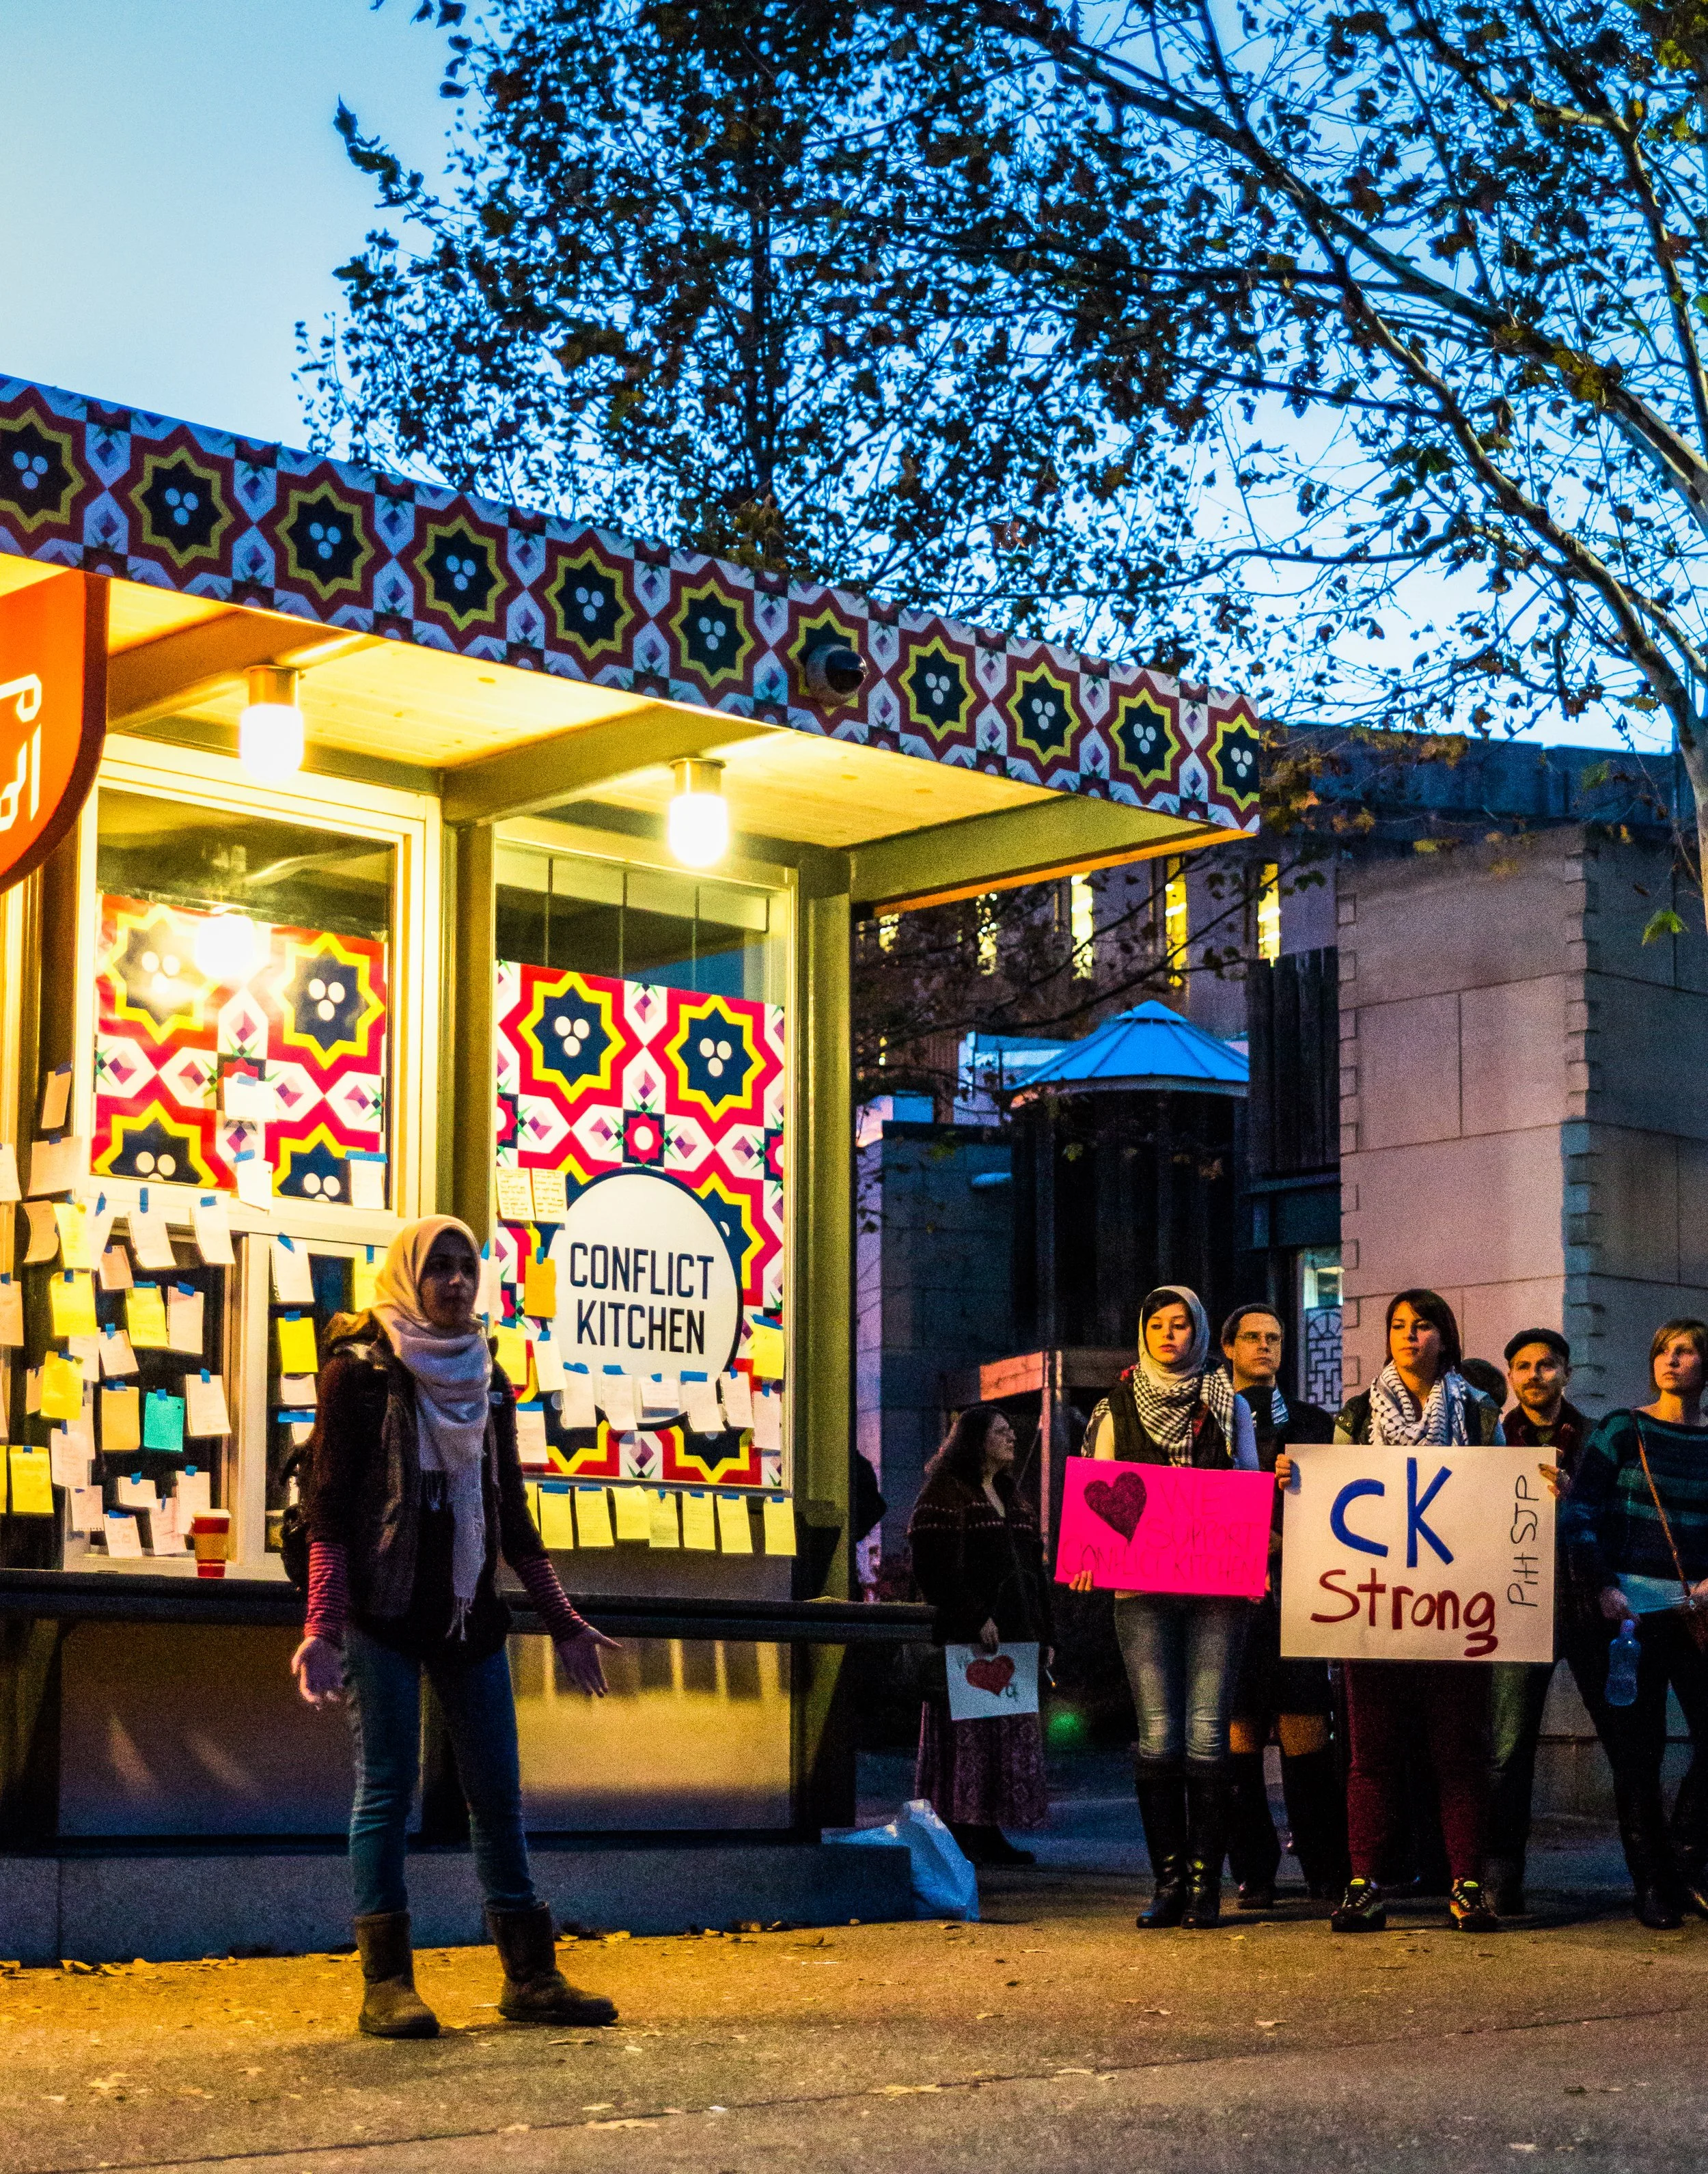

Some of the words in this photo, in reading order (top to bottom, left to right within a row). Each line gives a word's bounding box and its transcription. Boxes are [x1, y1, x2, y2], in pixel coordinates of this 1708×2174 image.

[570, 1241, 715, 1300] CONFLICT
[577, 1298, 704, 1355] KITCHEN
[1160, 1478, 1227, 1517] WE
[1330, 1457, 1455, 1568] CK
[1510, 1474, 1539, 1544] SJP
[1145, 1517, 1263, 1553] SUPPORT
[1173, 1552, 1259, 1586] KITCHEN
[1310, 1567, 1499, 1658] Strong
